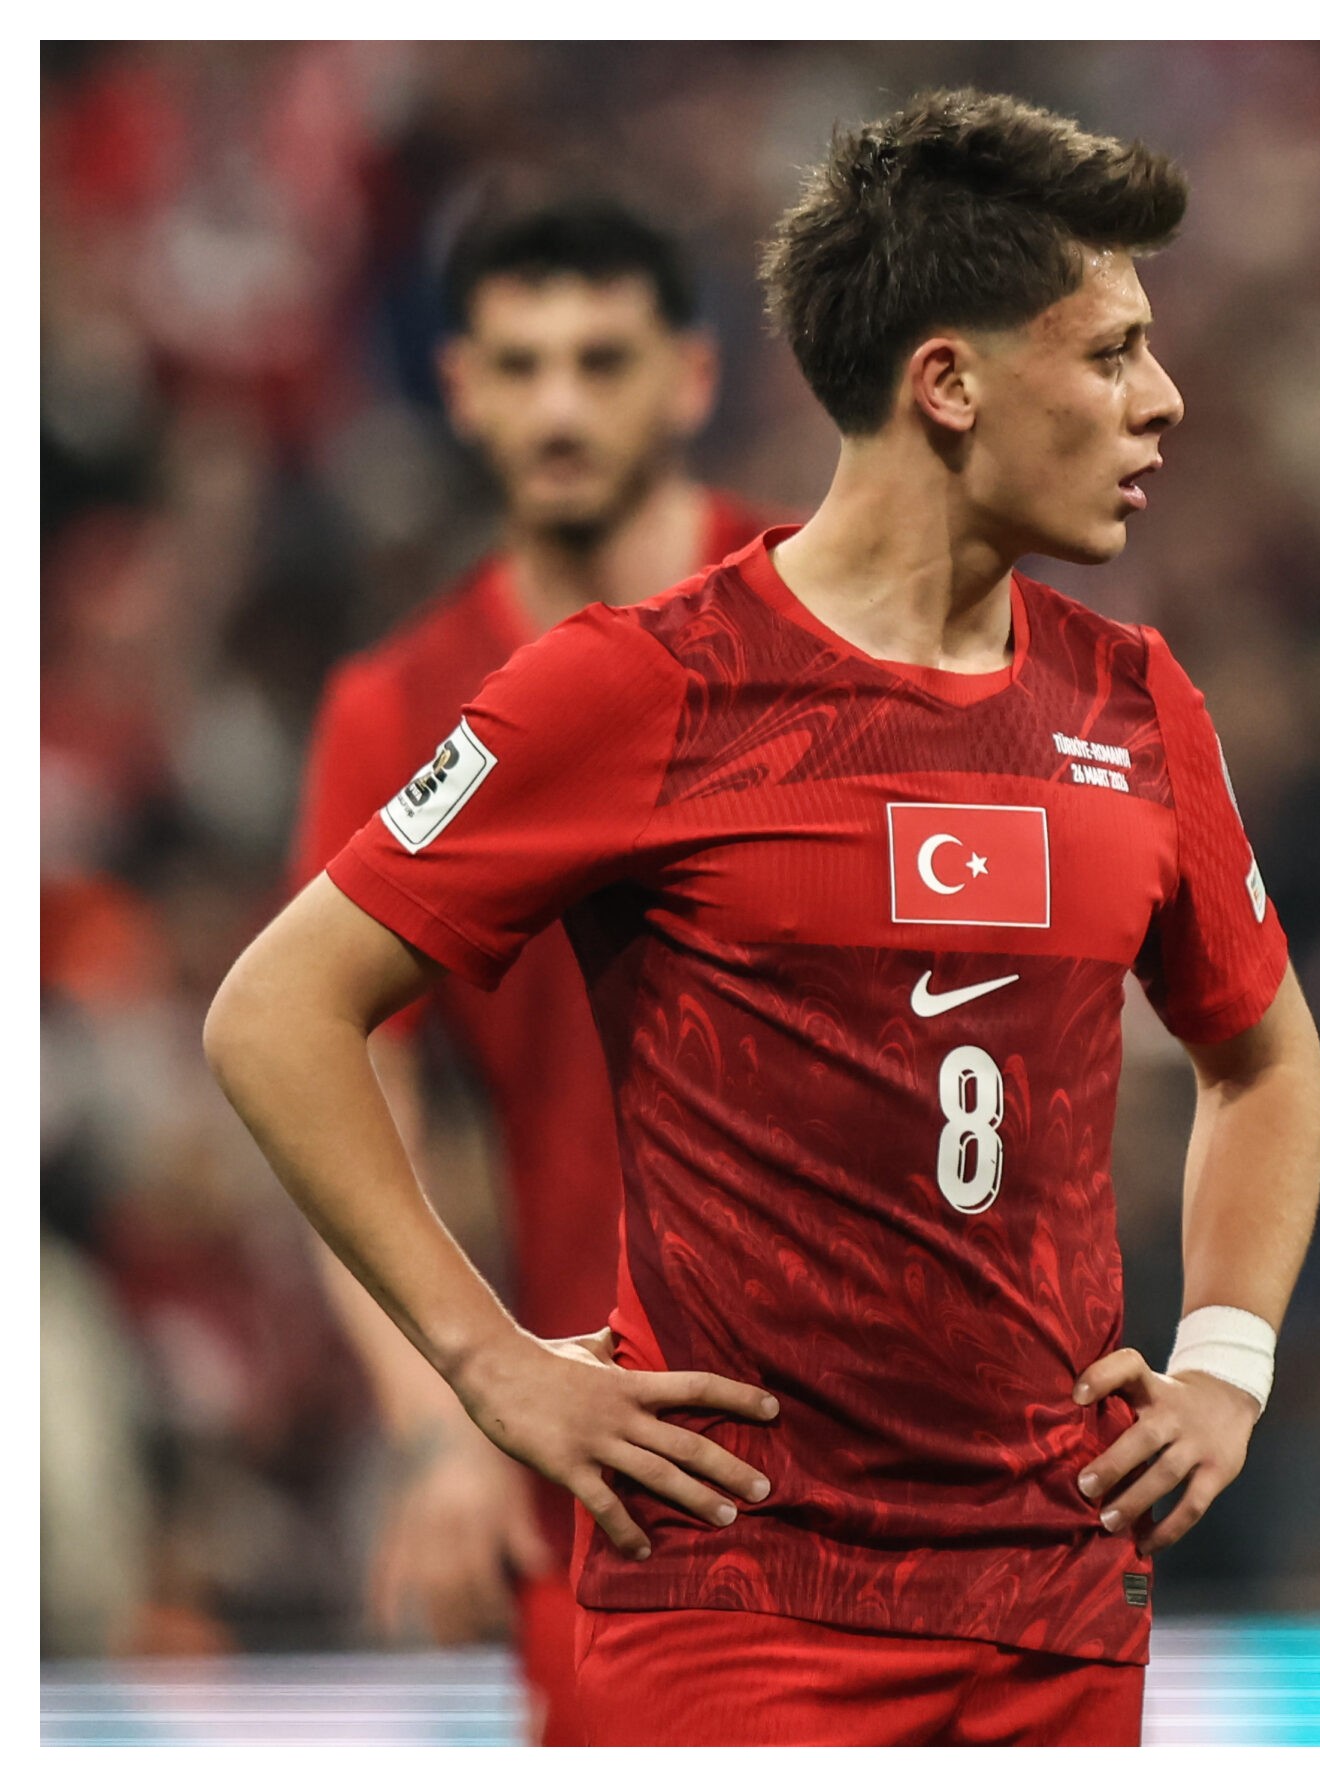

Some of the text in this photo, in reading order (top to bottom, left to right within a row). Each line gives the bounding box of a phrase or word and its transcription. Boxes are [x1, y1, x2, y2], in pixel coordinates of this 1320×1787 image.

[1070, 763, 1085, 783] 26
[1083, 765, 1110, 787] MART
[937, 1045, 1004, 1215] 8
